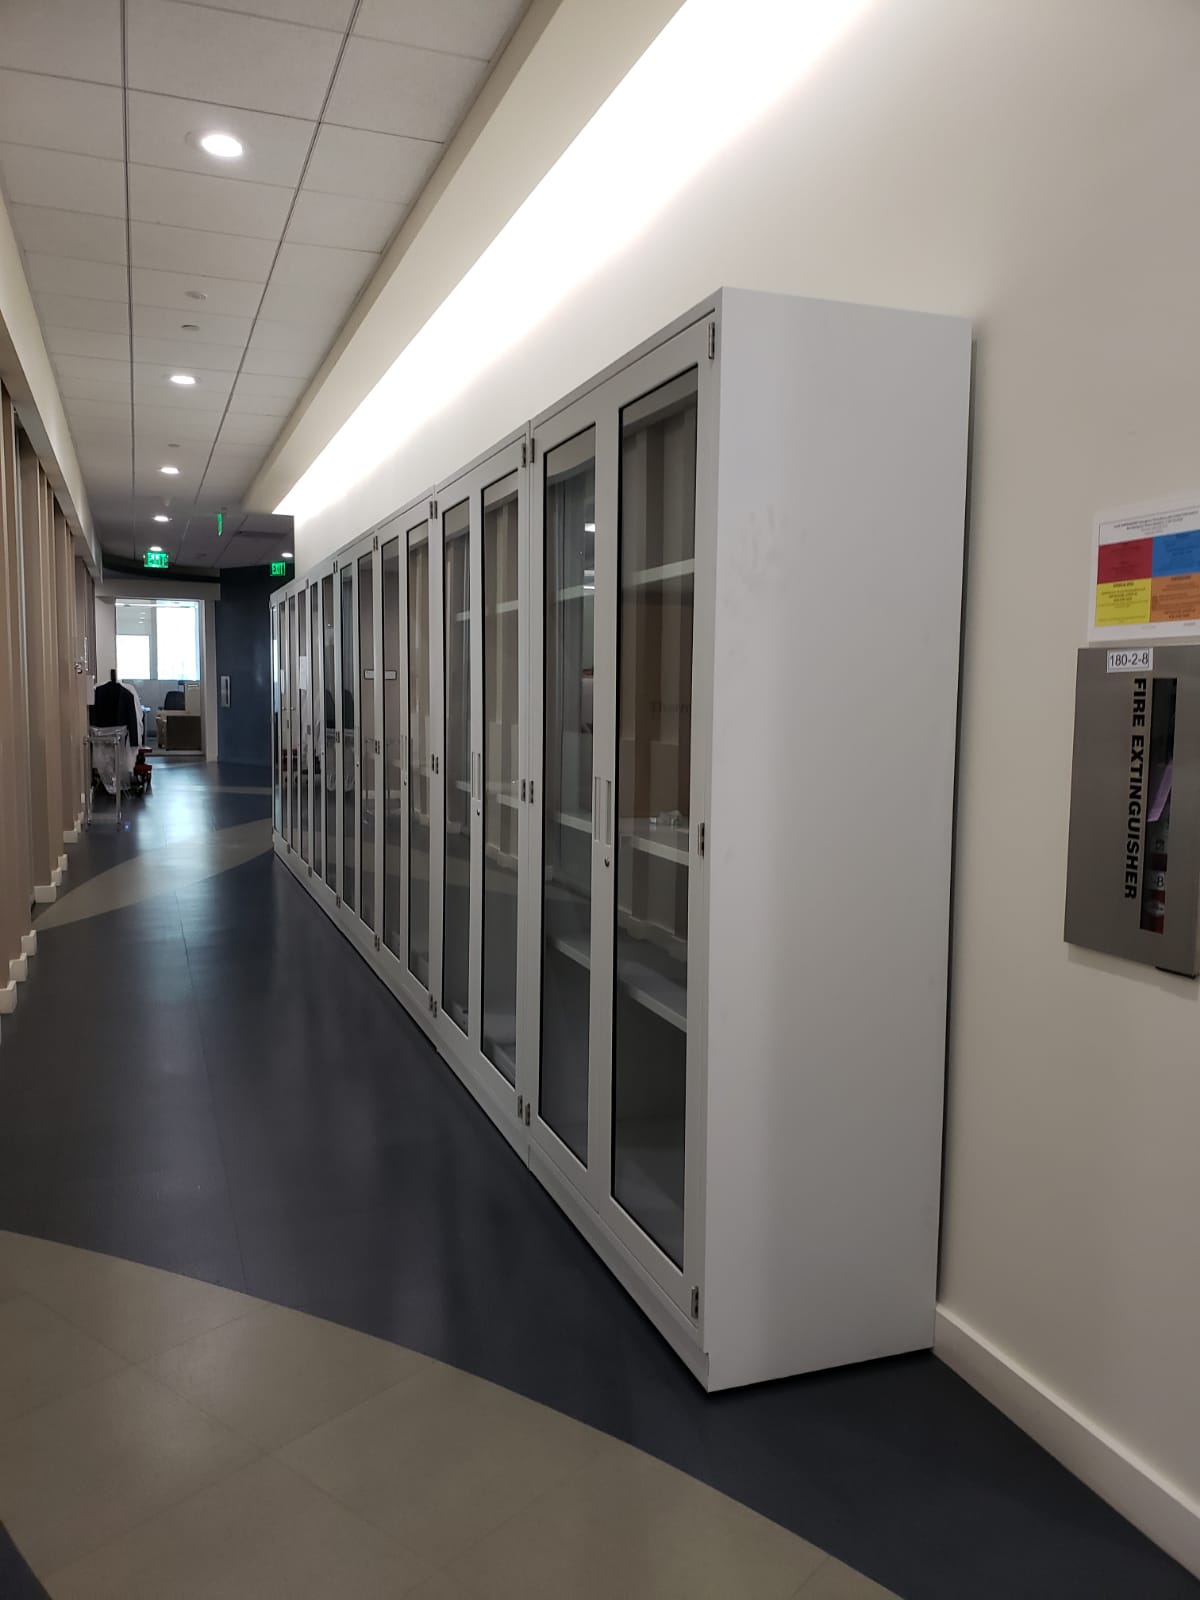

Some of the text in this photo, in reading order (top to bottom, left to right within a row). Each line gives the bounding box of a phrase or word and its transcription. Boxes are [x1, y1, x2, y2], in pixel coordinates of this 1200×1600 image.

[272, 562, 284, 576] EXIT
[1110, 653, 1149, 667] 180-2-8
[1124, 677, 1147, 900] FIRE EXTINGUISHER
